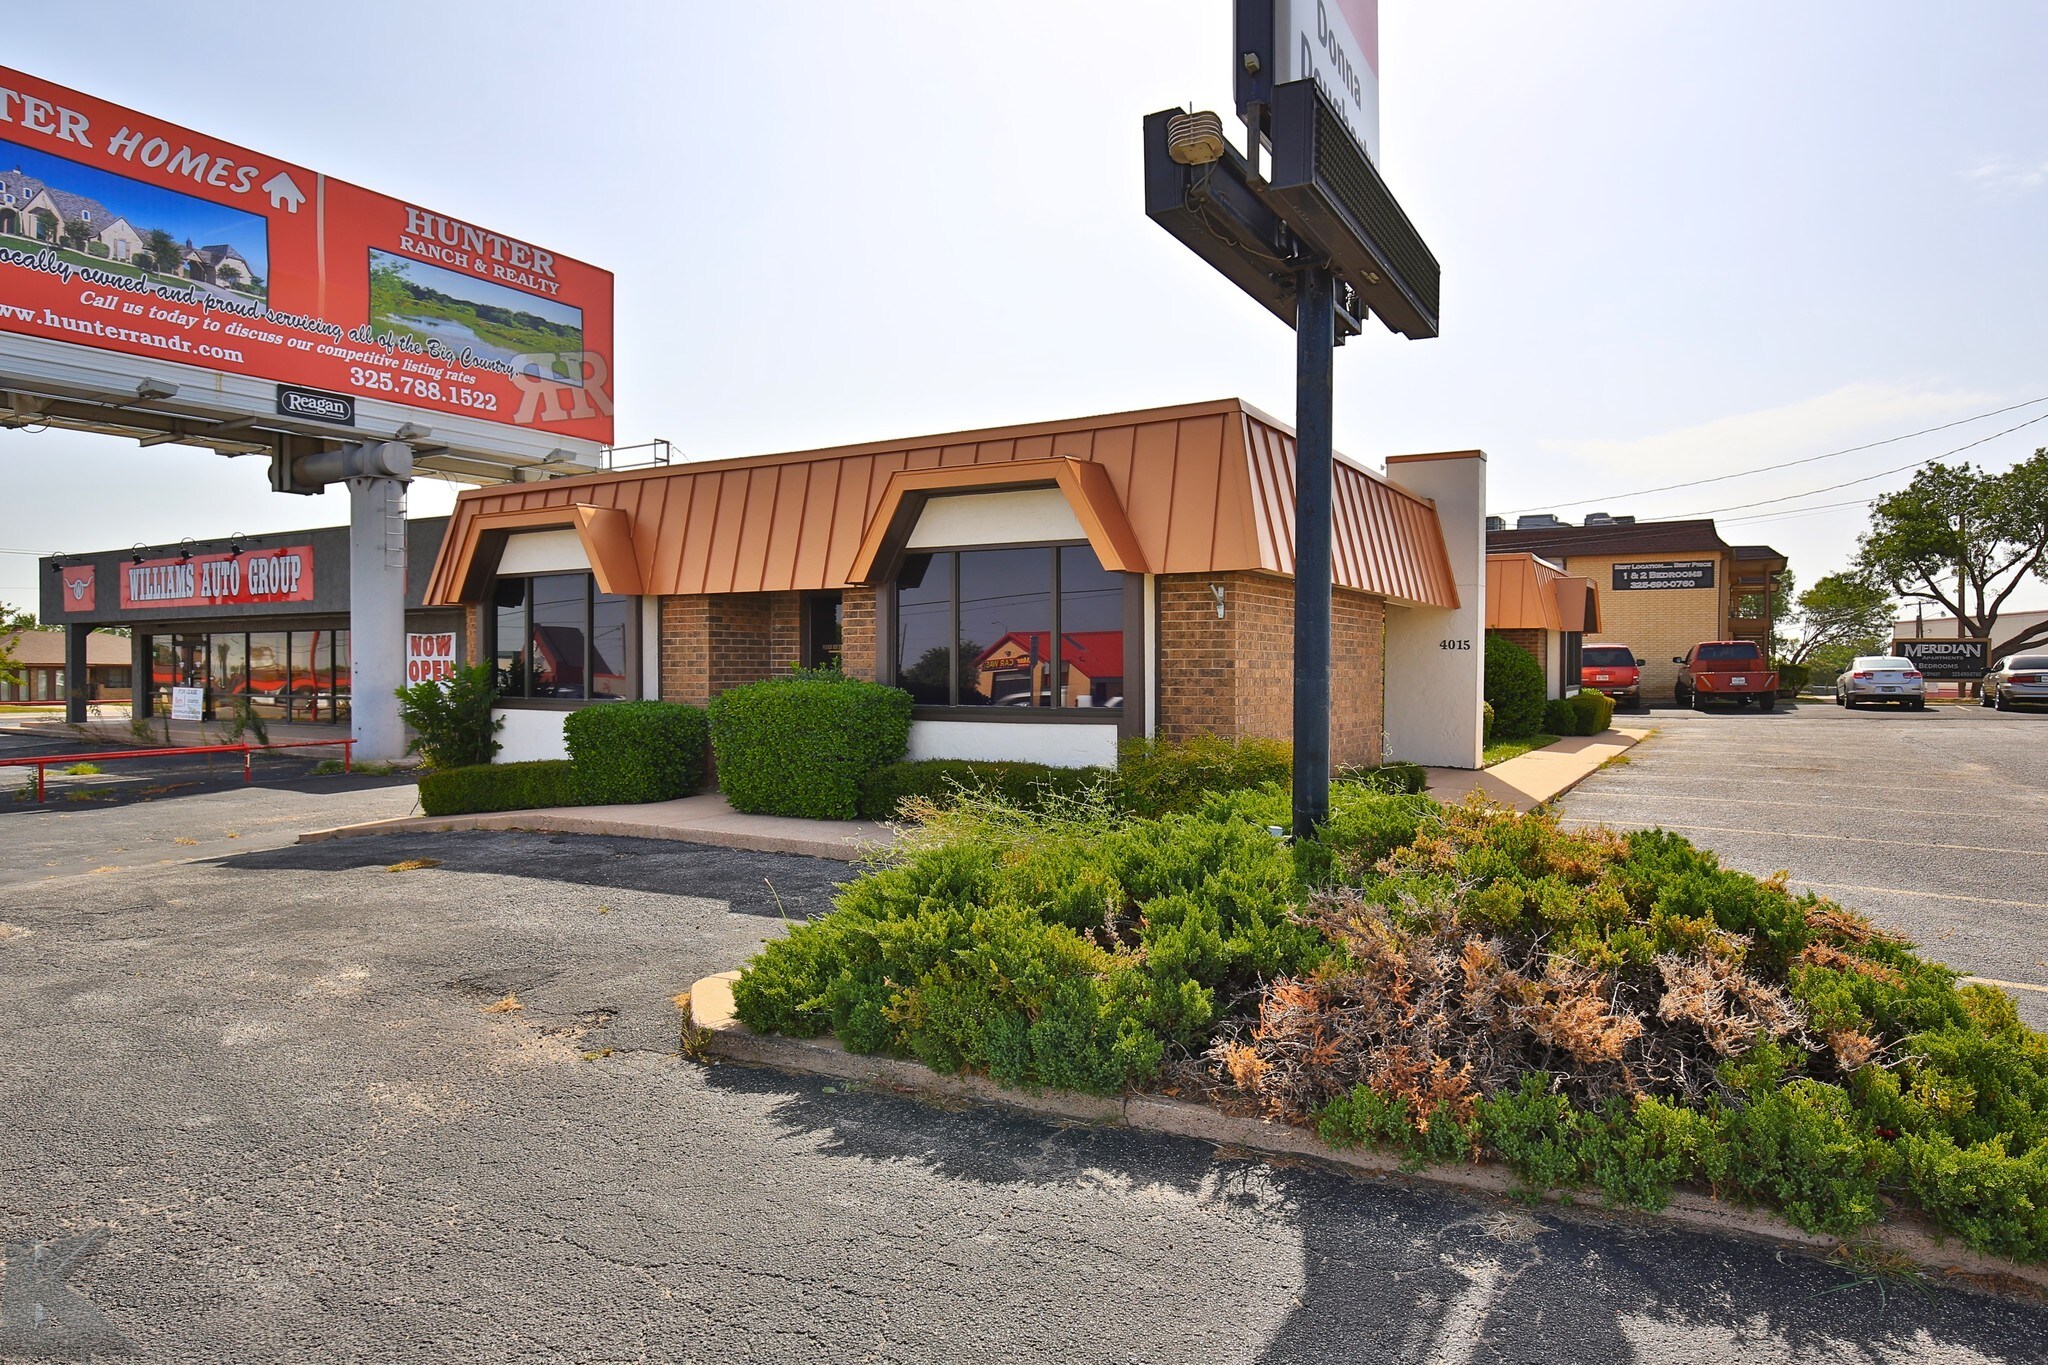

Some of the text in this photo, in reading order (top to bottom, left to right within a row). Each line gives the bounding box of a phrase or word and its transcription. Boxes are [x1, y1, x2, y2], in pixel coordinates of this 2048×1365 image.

[1317, 0, 1361, 112] Donna
[0, 86, 259, 193] TER HOMES
[400, 235, 559, 295] RANCH & REALTY
[405, 207, 556, 278] HUNTER
[80, 267, 150, 295] owned
[156, 286, 196, 305] and
[202, 293, 260, 320] proud
[266, 310, 343, 342] servicing
[348, 324, 374, 344] all
[378, 333, 394, 354] of
[398, 333, 422, 355] the
[426, 339, 454, 367] Big
[459, 347, 519, 379] Country.
[80, 291, 476, 385] Call us today to discuss our competitive listing rates
[289, 394, 344, 414] Reagan
[350, 367, 497, 412] 325.788.1522
[128, 555, 301, 601] WILLIAMS AUTO GROUP
[1630, 572, 1639, 580] &
[411, 635, 451, 657] NOW
[1439, 639, 1471, 651] 4015
[1904, 644, 1981, 657] MERIDIAN
